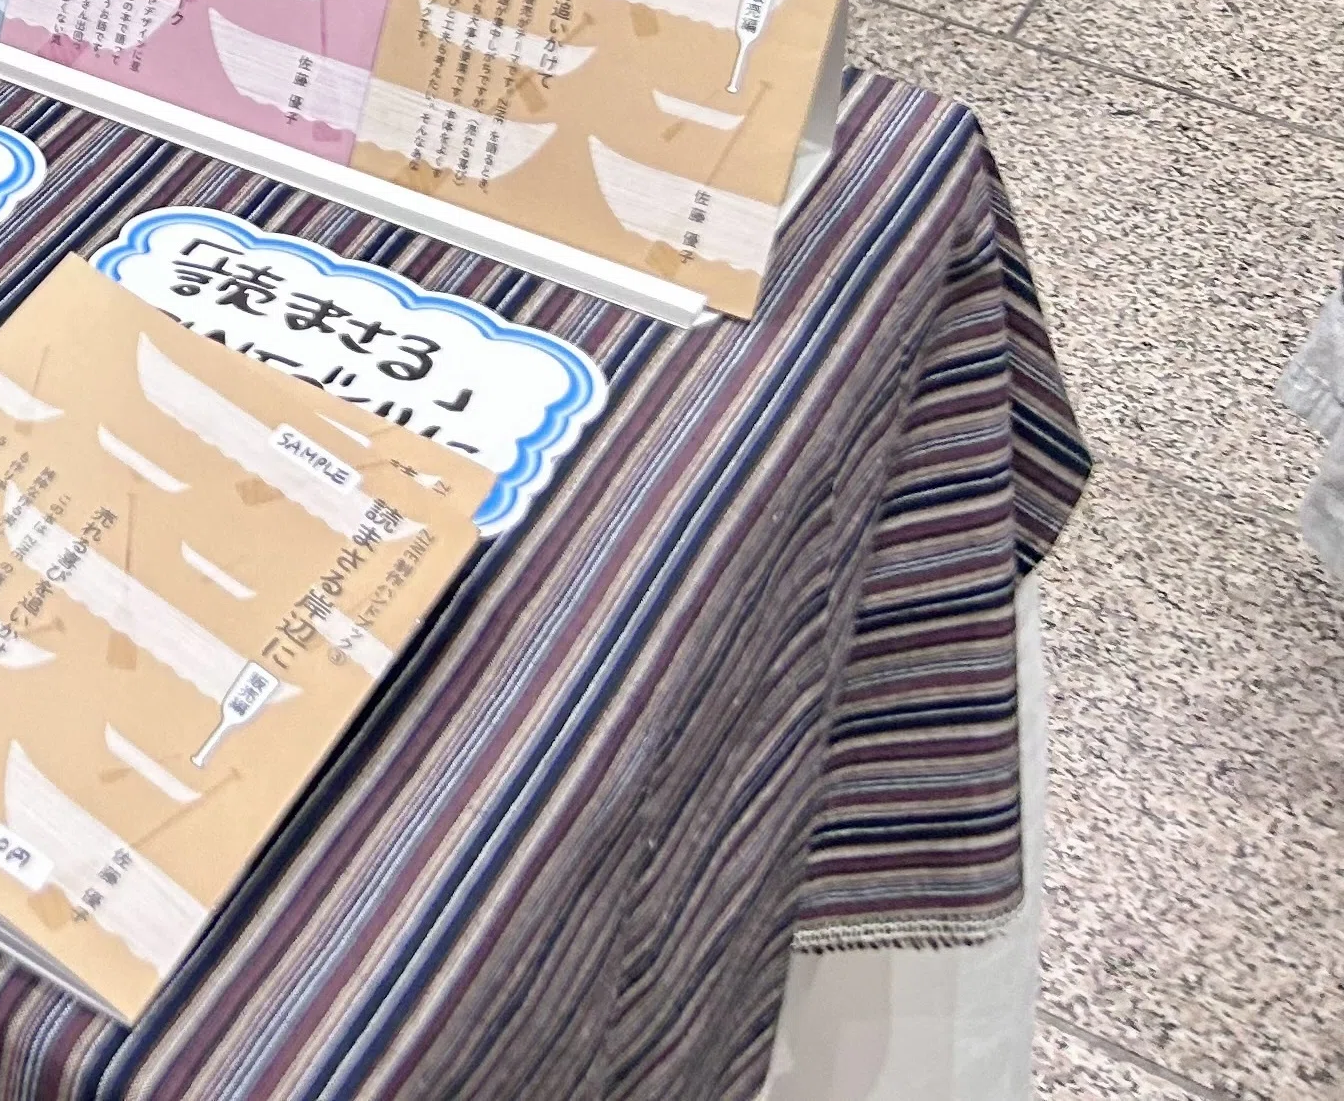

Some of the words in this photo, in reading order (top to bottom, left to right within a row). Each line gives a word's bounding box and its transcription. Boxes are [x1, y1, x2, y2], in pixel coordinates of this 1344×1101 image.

[169, 236, 477, 414] 「読まさる」
[275, 429, 352, 488] SAMPLE
[258, 495, 404, 676] 読まさる岸辺に
